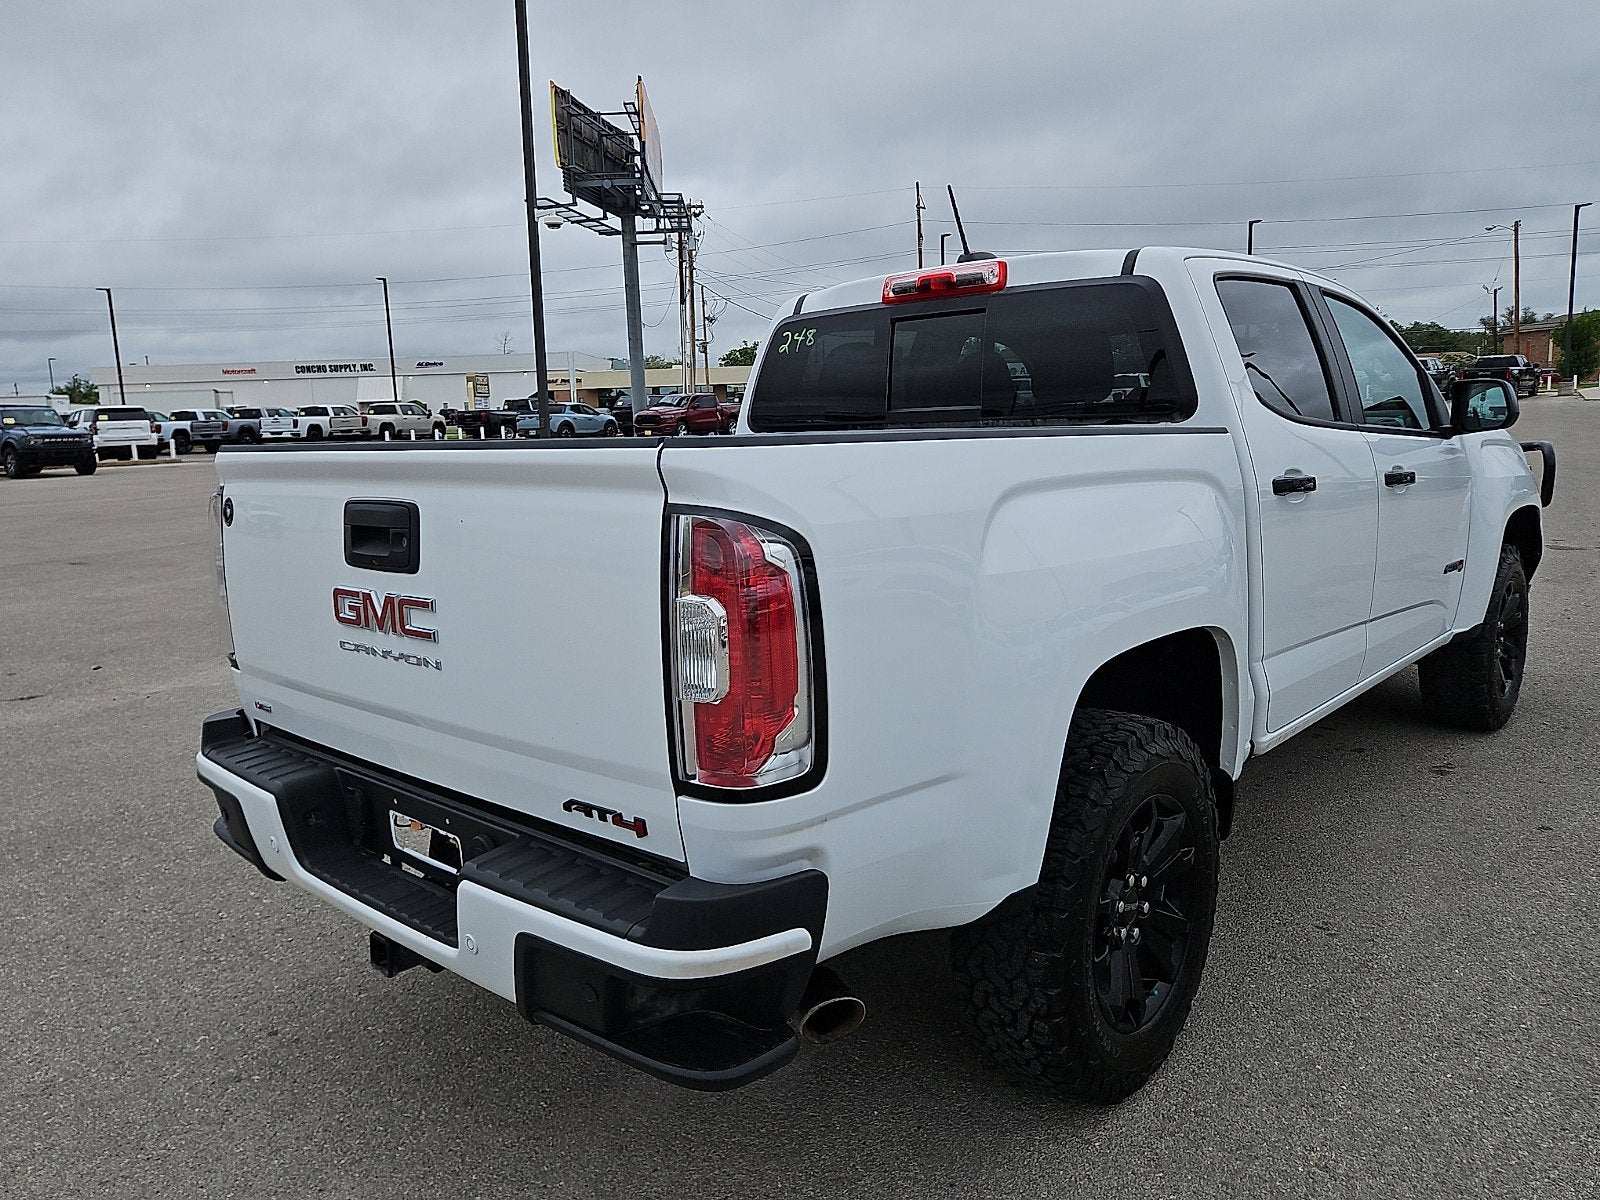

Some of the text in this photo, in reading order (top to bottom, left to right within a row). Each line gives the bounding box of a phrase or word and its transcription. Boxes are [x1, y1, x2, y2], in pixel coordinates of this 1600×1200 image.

[778, 328, 817, 355] 248
[221, 367, 257, 375] Motorcraft
[295, 362, 376, 374] CONCHO SUPPLY, INC.
[332, 585, 440, 644] GMC
[339, 639, 443, 671] CANYON
[562, 798, 650, 839] AT4
